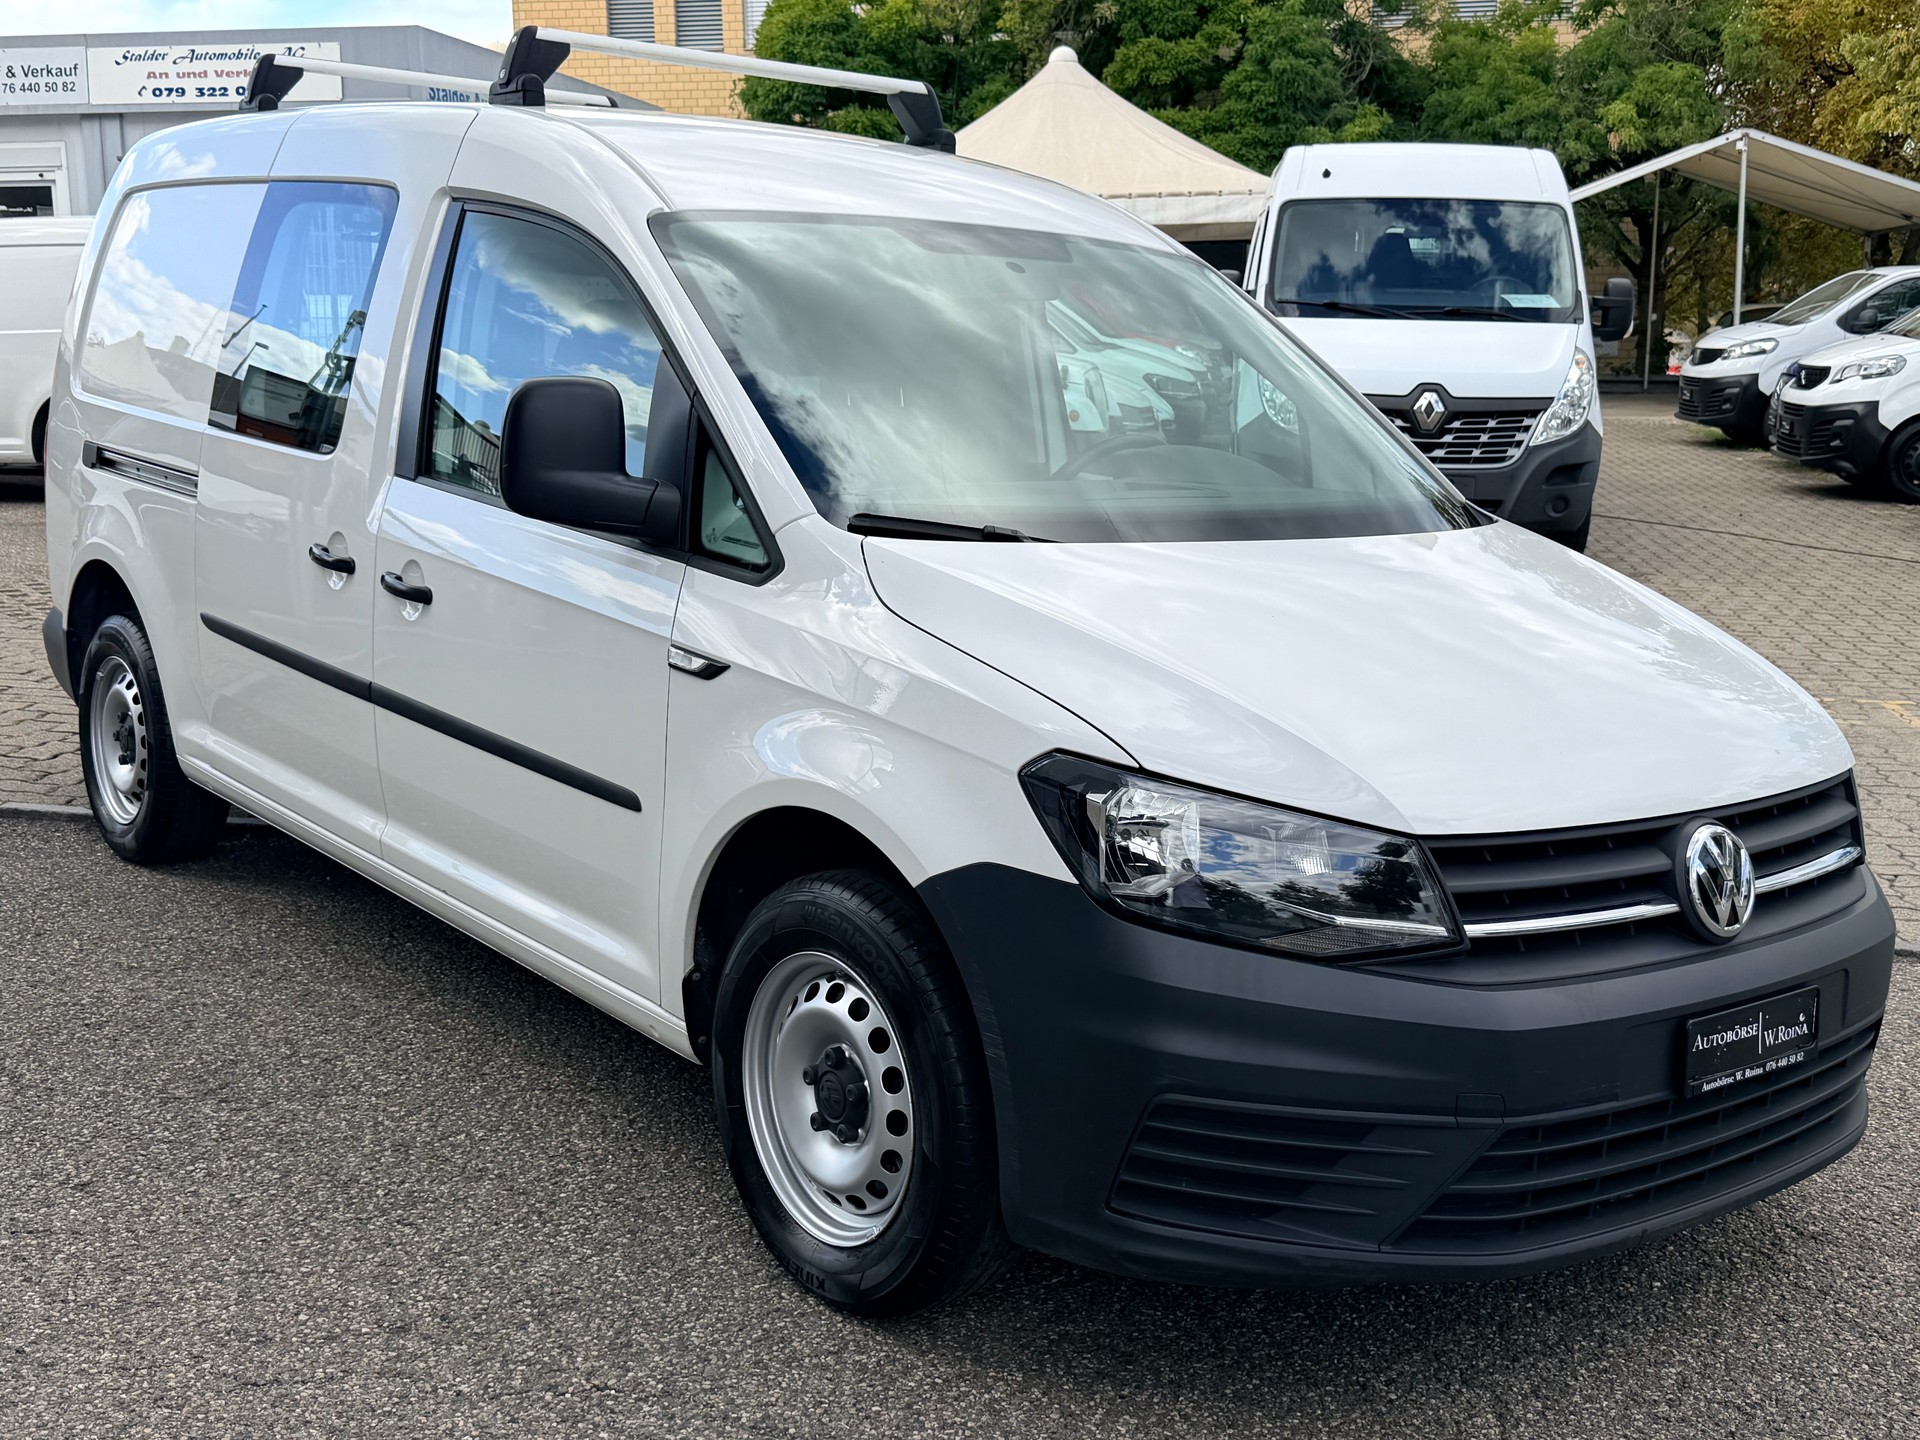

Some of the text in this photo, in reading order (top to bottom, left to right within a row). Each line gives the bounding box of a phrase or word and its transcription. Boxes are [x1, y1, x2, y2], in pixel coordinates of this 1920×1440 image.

[114, 49, 168, 66] Stalder
[172, 48, 261, 65] Automobile
[5, 63, 79, 79] & Verkauf
[146, 69, 251, 80] An und Verk
[19, 82, 40, 93] 440
[44, 81, 58, 93] 50
[62, 81, 76, 92] 82
[151, 87, 187, 98] 079
[195, 86, 229, 97] 322
[1701, 1076, 1735, 1092] Autobörse
[1745, 1066, 1764, 1079] Roina
[1765, 1060, 1777, 1072] 076
[1777, 1057, 1788, 1068] 440
